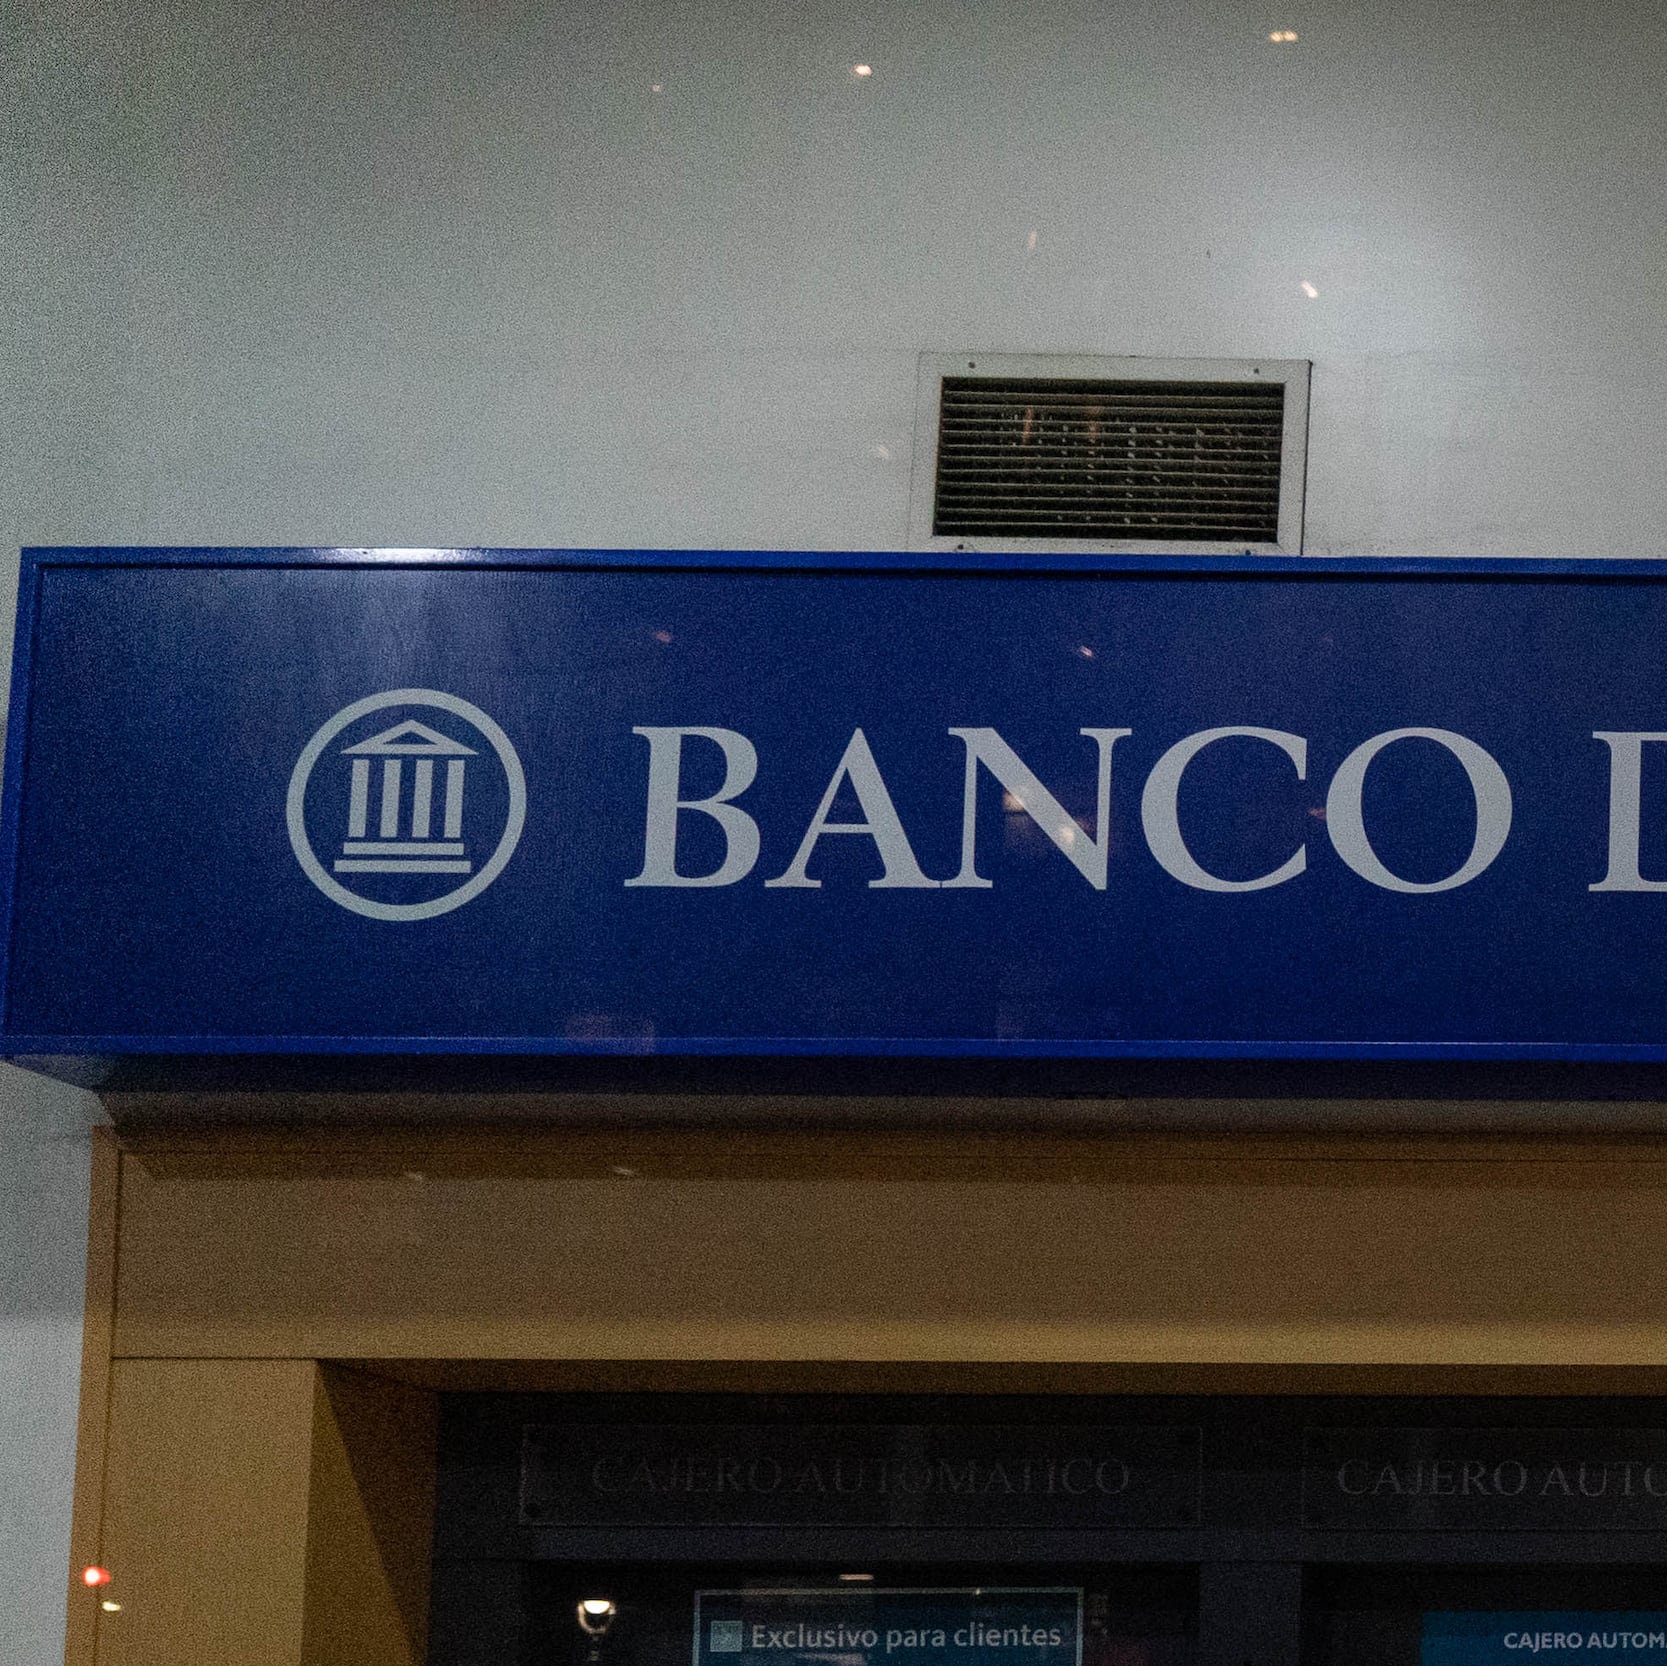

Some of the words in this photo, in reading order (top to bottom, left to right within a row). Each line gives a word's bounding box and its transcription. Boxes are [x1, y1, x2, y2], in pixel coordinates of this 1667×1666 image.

[625, 725, 1514, 893] BANCO
[593, 1458, 782, 1496] CAJERO
[793, 1458, 1131, 1496] AUTOMATICO
[1336, 1460, 1528, 1498] CAJERO
[751, 1622, 879, 1649] Exclusivo
[885, 1629, 947, 1655] para
[954, 1622, 1062, 1648] clientes
[1503, 1631, 1583, 1653] CAJERO
